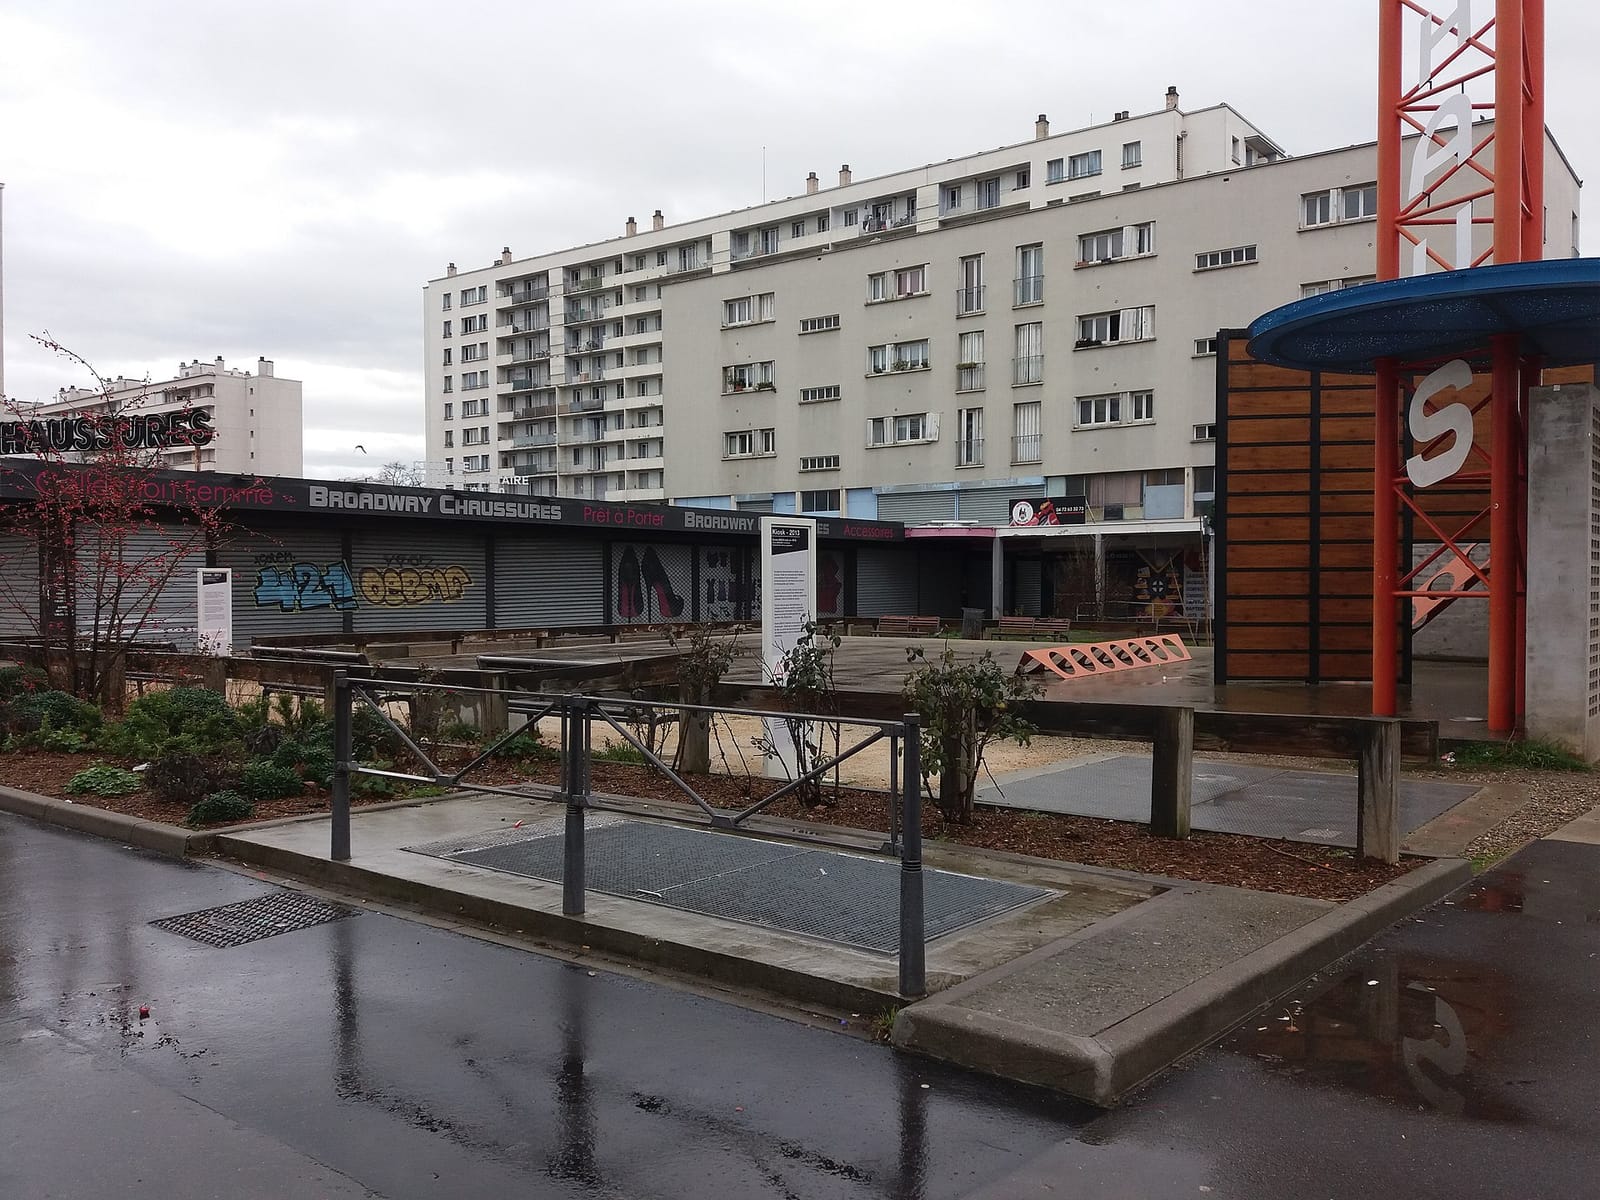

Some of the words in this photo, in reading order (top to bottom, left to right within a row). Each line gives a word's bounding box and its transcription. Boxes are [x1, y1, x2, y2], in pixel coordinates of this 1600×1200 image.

[185, 480, 274, 505] Femme
[309, 485, 432, 513] BROADWAY
[439, 494, 562, 520] CHAUSSURES
[583, 505, 611, 523] Prêt
[627, 509, 666, 528] Porter
[684, 511, 755, 531] BROADWAY
[772, 528, 785, 536] Kiosk
[843, 524, 894, 539] Accessoires
